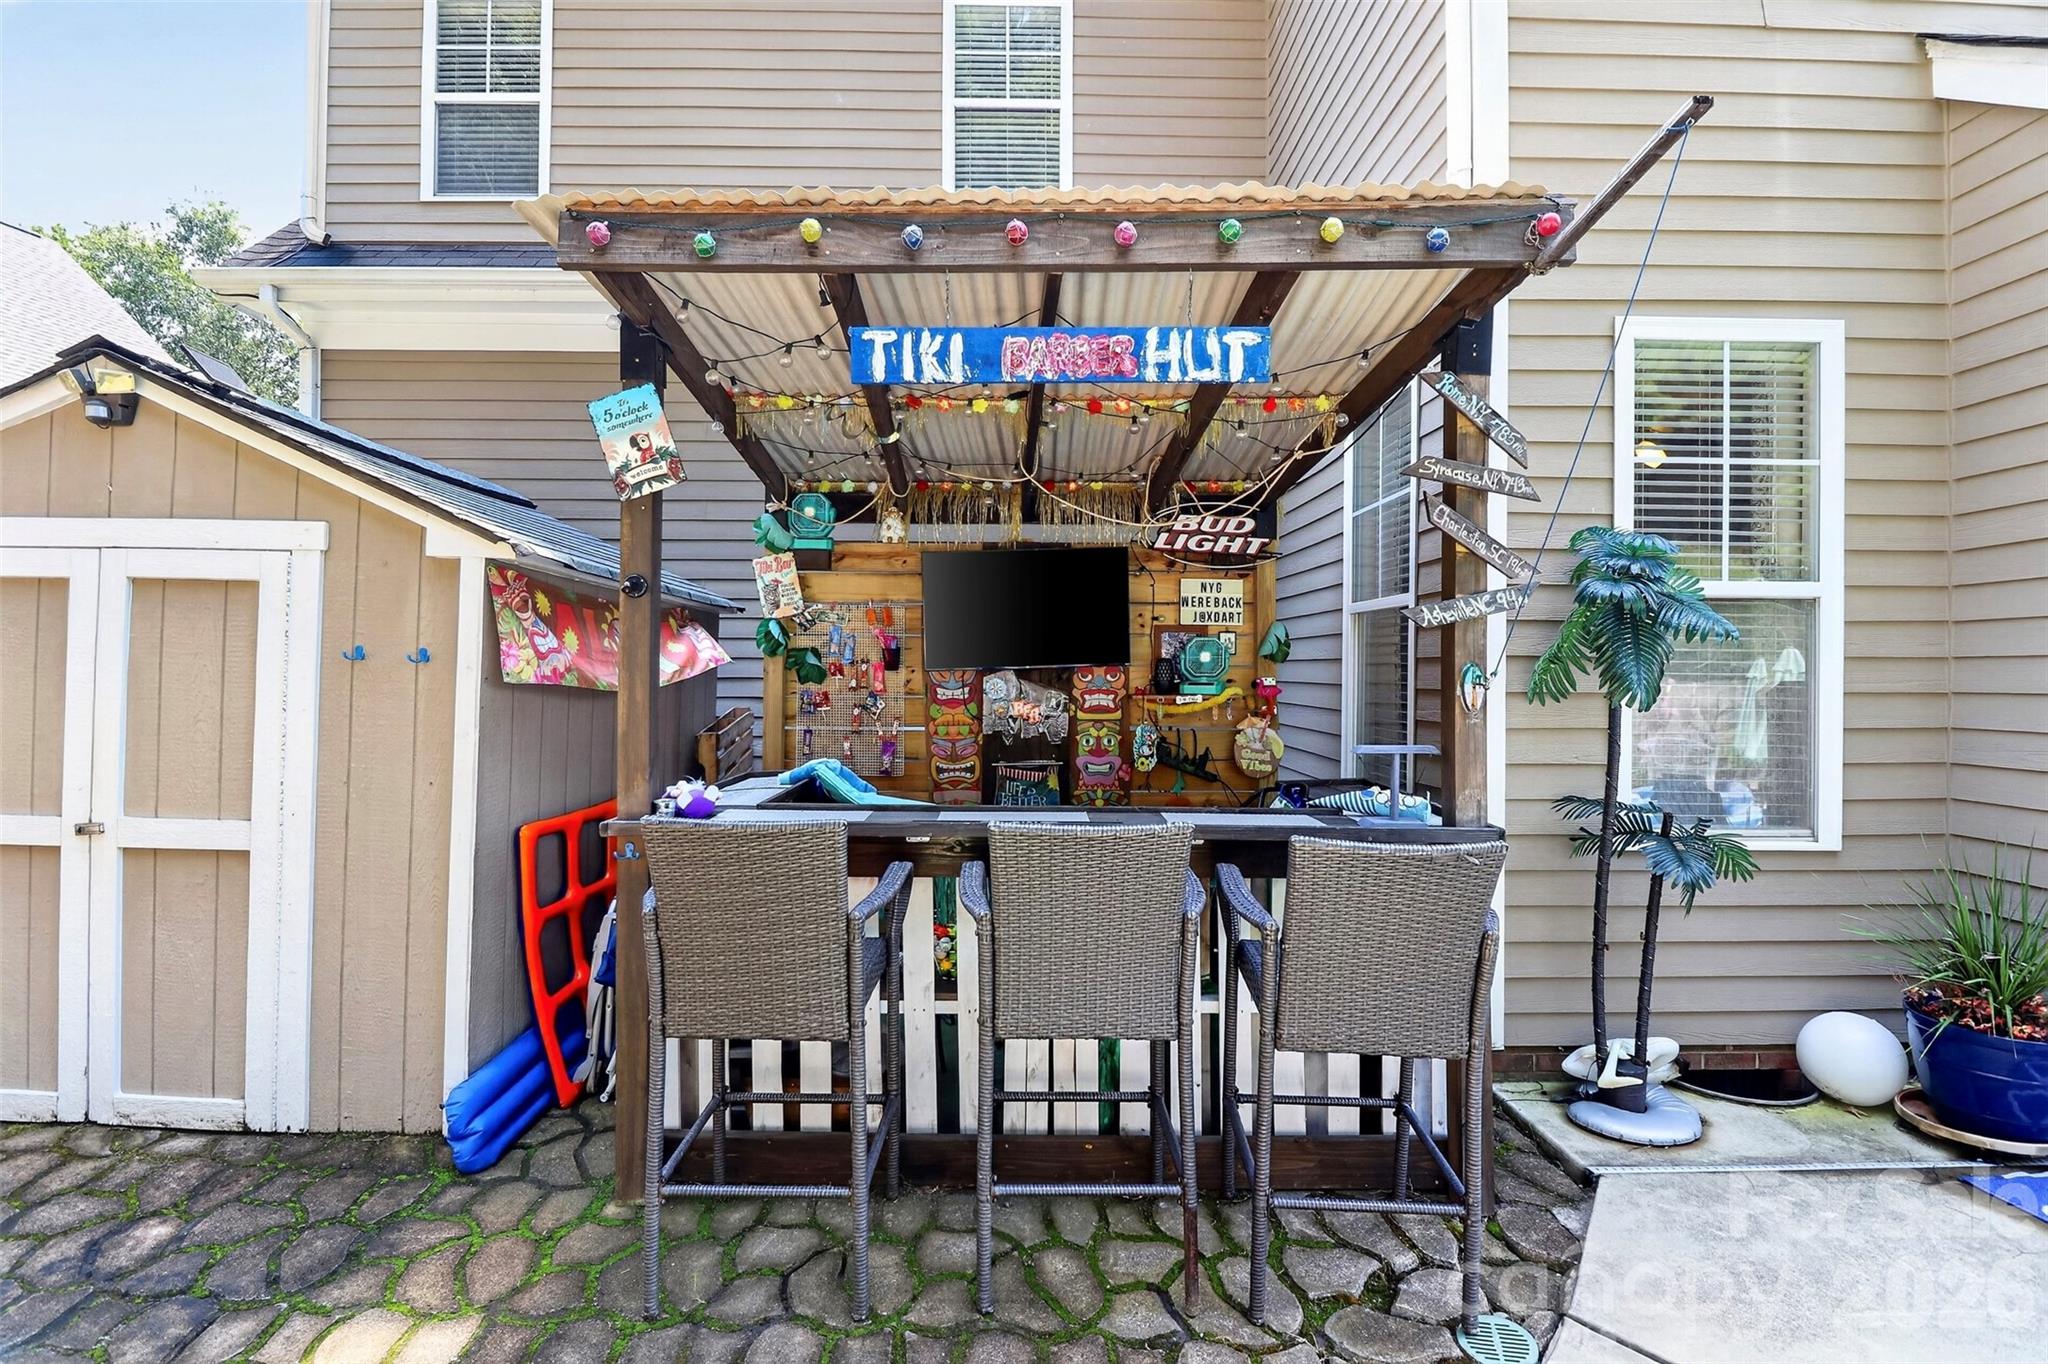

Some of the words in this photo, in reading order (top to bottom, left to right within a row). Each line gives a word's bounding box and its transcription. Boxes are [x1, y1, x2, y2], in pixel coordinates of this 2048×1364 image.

[861, 327, 967, 384] TIKI
[1143, 326, 1264, 384] HUT
[603, 408, 614, 424] 5
[614, 400, 649, 420] o'clock
[606, 411, 654, 433] somewhere
[630, 464, 665, 480] welcome
[1418, 458, 1482, 487] Syracuse,
[1173, 514, 1256, 534] BUD
[1153, 532, 1270, 556] LIGHT
[1432, 504, 1487, 556] Charleston,
[1487, 543, 1507, 566] SC
[773, 555, 795, 573] Bar
[1200, 582, 1223, 593] NYG
[1240, 759, 1272, 772] Vibes
[1241, 749, 1271, 761] Good
